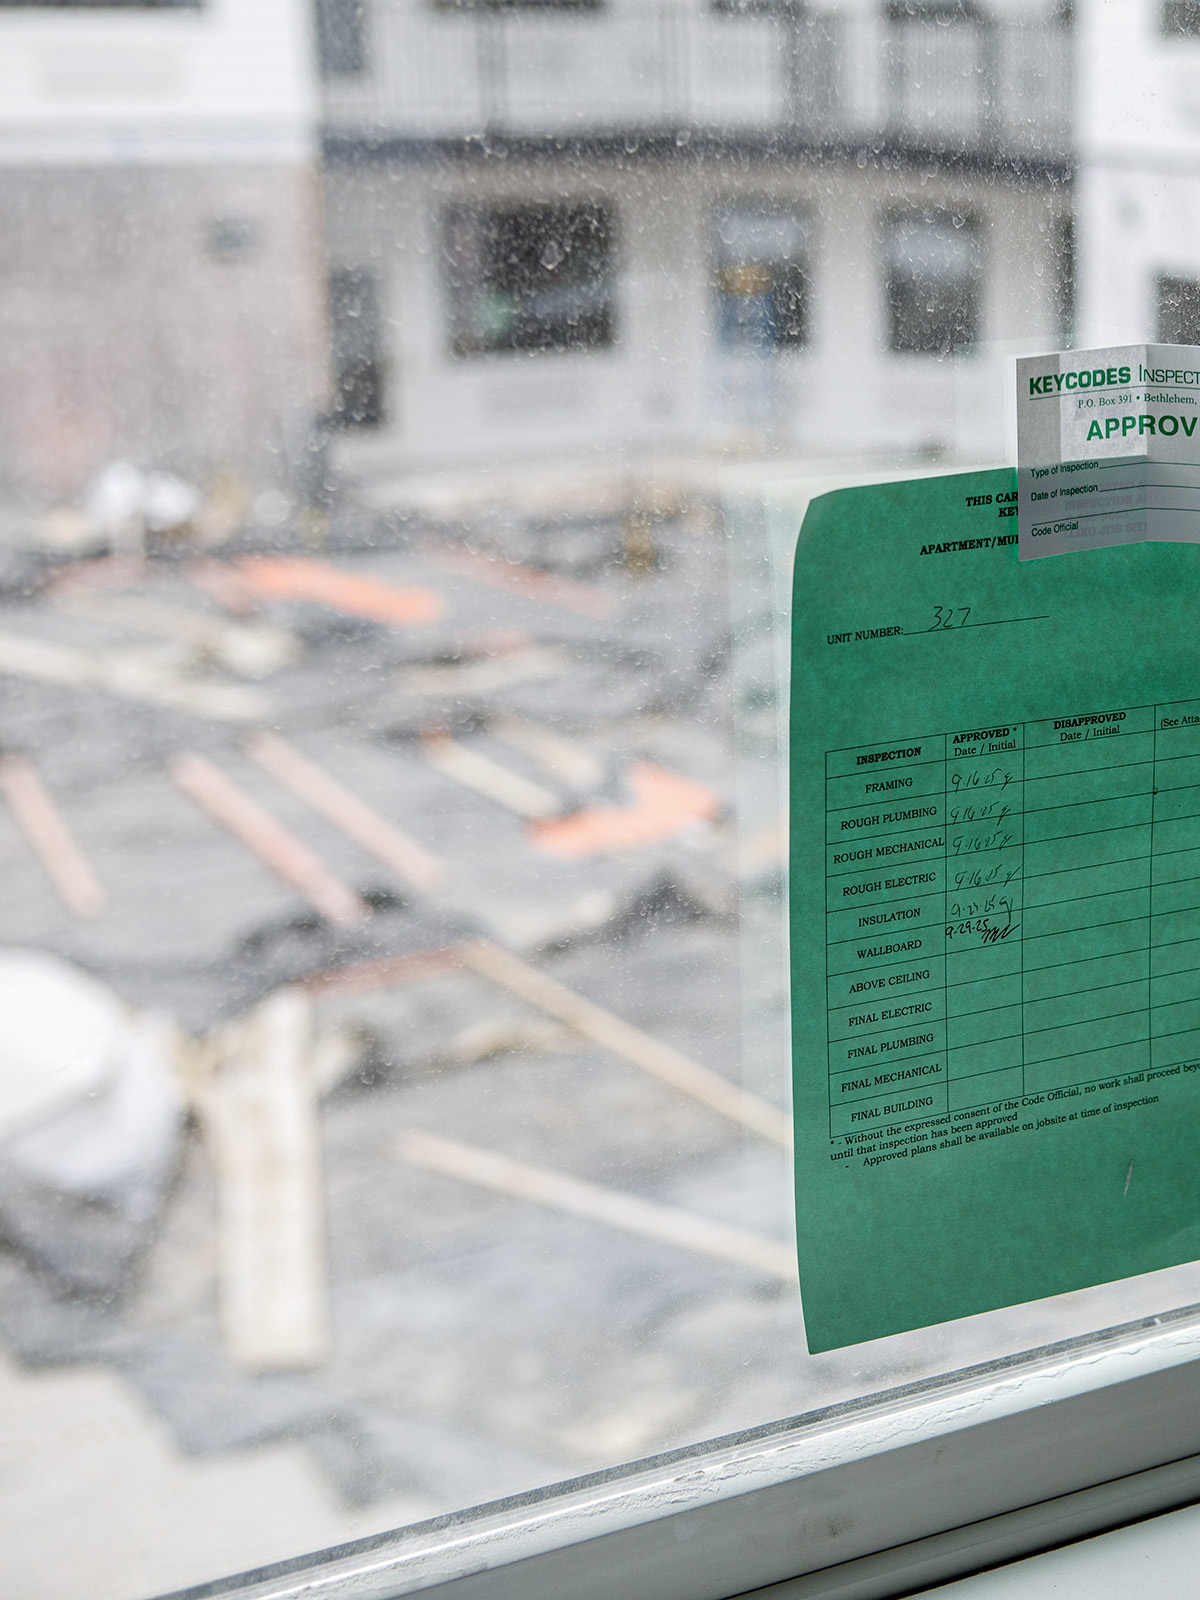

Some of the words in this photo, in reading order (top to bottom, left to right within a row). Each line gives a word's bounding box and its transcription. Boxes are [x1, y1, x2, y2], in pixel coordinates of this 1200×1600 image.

[1029, 366, 1131, 395] KEYCODES
[1078, 400, 1096, 409] P.O.
[1099, 396, 1116, 407] Box
[1118, 394, 1134, 405] 391
[1144, 393, 1198, 406] Bethlehem,
[1030, 468, 1049, 480] Type
[1050, 466, 1059, 475] of
[1060, 460, 1099, 474] Inspection
[966, 494, 992, 507] THIS
[1030, 491, 1049, 502] Date
[1050, 488, 1058, 499] of
[1060, 484, 1098, 496] Inspection
[1031, 526, 1052, 538] Code
[1054, 521, 1078, 534] Official
[928, 606, 971, 632] 327
[827, 633, 852, 645] UNIT
[854, 626, 904, 641] NUMBER:
[1053, 712, 1126, 730] DISAPPROVED
[1160, 716, 1179, 730] (See
[952, 728, 1010, 744] APPROVED
[1060, 730, 1082, 742] Date
[1092, 724, 1120, 737] Initial
[856, 746, 922, 766] INSPECTION
[954, 746, 977, 757] Date
[988, 739, 1016, 752] Initial
[865, 778, 914, 794] FRAMING
[840, 816, 880, 831] ROUGH
[882, 806, 937, 824] PLUMBING
[833, 849, 873, 864] ROUGH
[876, 838, 945, 858] MECHANICAL
[842, 882, 882, 896] ROUGH
[884, 872, 936, 889] ELECTRIC
[858, 908, 921, 928] INSULATION
[857, 940, 922, 960] WALLBOARD
[849, 979, 886, 994] ABOVE
[888, 970, 930, 986] CEILING
[848, 1014, 879, 1028] FINAL
[881, 1002, 932, 1020] ELECTRIC
[847, 1046, 878, 1060] FINAL
[880, 1033, 934, 1052] PLUMBING
[841, 1078, 872, 1092] FINAL
[874, 1064, 942, 1086] MECHANICAL
[844, 1129, 884, 1146] Without
[886, 1125, 902, 1138] the
[904, 1115, 951, 1135] expressed
[953, 1106, 991, 1122] consent
[992, 1103, 1003, 1114] of
[1004, 1100, 1020, 1111] the
[1021, 1094, 1046, 1108] Code
[1047, 1086, 1082, 1102] Official,
[1084, 1084, 1097, 1094] no
[1098, 1078, 1121, 1092] work
[1122, 1073, 1145, 1086] shall
[1146, 1064, 1181, 1082] proceed
[850, 1109, 881, 1122] FINAL
[884, 1096, 934, 1116] BUILDING
[830, 1148, 854, 1162] until
[856, 1143, 877, 1156] that
[879, 1132, 928, 1152] inspection
[930, 1128, 948, 1140] has
[950, 1122, 974, 1135] been
[975, 1112, 1018, 1130] approved
[862, 1149, 908, 1168] Approved
[910, 1142, 938, 1157] plans
[940, 1136, 963, 1150] shall
[965, 1132, 976, 1144] be
[978, 1123, 1020, 1142] available
[1022, 1121, 1034, 1132] on
[1035, 1112, 1067, 1131] jobsite
[1069, 1111, 1079, 1122] at
[1080, 1106, 1101, 1119] time
[1102, 1102, 1112, 1114] of
[1114, 1094, 1160, 1112] inspection
